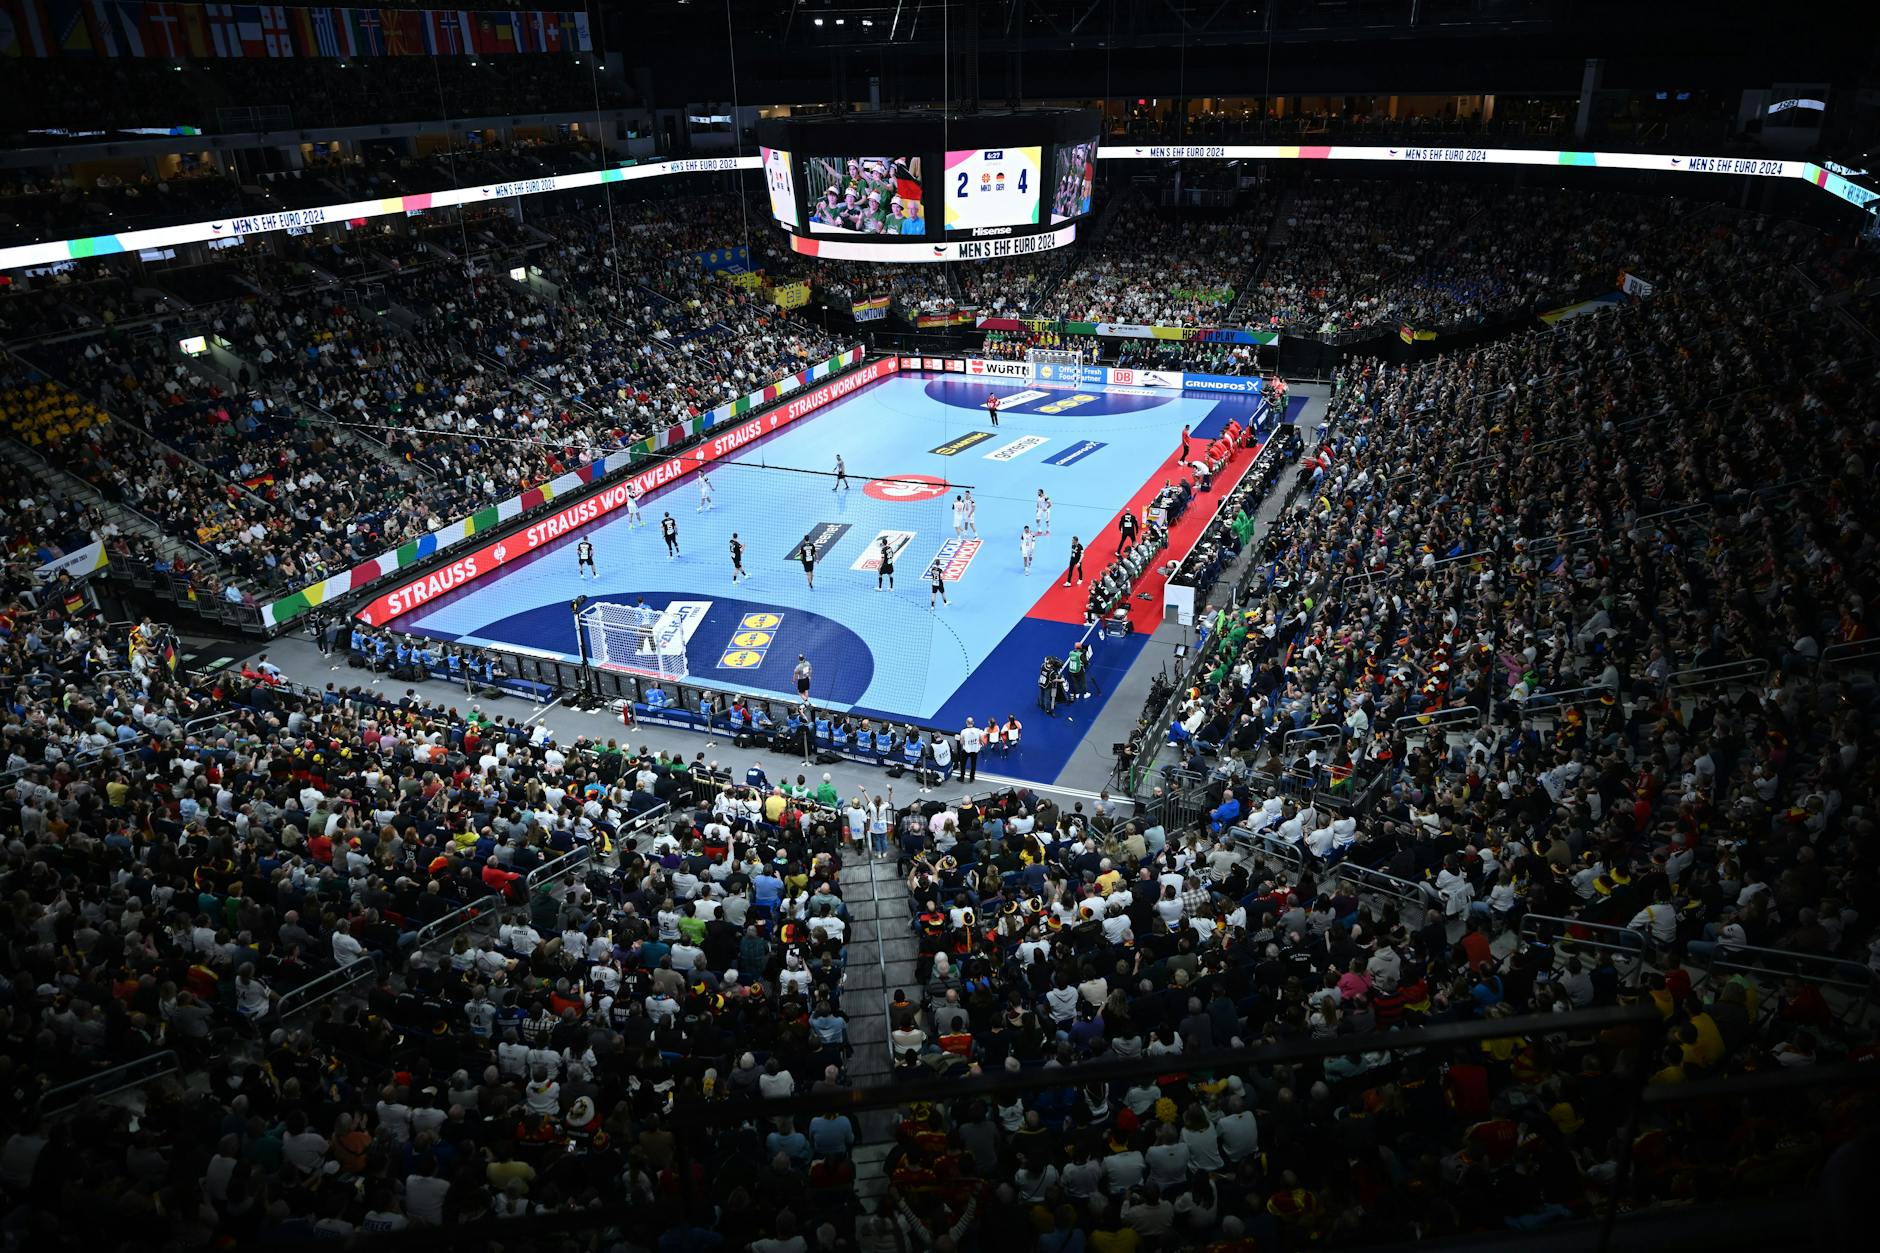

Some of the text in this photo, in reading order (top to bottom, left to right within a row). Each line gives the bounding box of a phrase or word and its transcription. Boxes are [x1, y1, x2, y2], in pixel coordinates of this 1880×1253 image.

[986, 152, 1001, 160] 6:27
[1172, 147, 1185, 157] EHF
[1186, 147, 1205, 157] EURO
[1206, 147, 1225, 157] 2024
[1429, 149, 1443, 160] EHF
[1444, 149, 1464, 161] EURO
[1465, 150, 1487, 161] 2024
[685, 160, 698, 171] EHF
[699, 160, 717, 170] EURO
[719, 159, 738, 169] 2024
[1716, 159, 1733, 172] EHF
[1734, 160, 1757, 174] EURO
[1758, 161, 1783, 175] 2024
[514, 182, 524, 195] EHF
[525, 180, 540, 193] EURO
[541, 178, 556, 191] 2024
[957, 172, 969, 198] 2
[1017, 168, 1028, 194] 4
[262, 215, 277, 230] EHF
[279, 212, 301, 229] EURO
[303, 208, 325, 225] 2024
[972, 226, 1012, 237] Hisense
[994, 240, 1011, 256] EHF
[1014, 237, 1036, 254] EURO
[1038, 233, 1056, 250] 2024
[1182, 329, 1237, 342] HERE TO PLAY
[1084, 367, 1102, 375] Fresh
[1115, 370, 1131, 383] DB
[788, 365, 878, 419] STRAUSS WORKWEAR
[1185, 380, 1246, 391] GRUNDFOS
[714, 420, 762, 456] STRAUSS
[526, 499, 598, 547] STRAUSS
[387, 557, 477, 615] STRAUSS
[663, 921, 670, 931] 5
